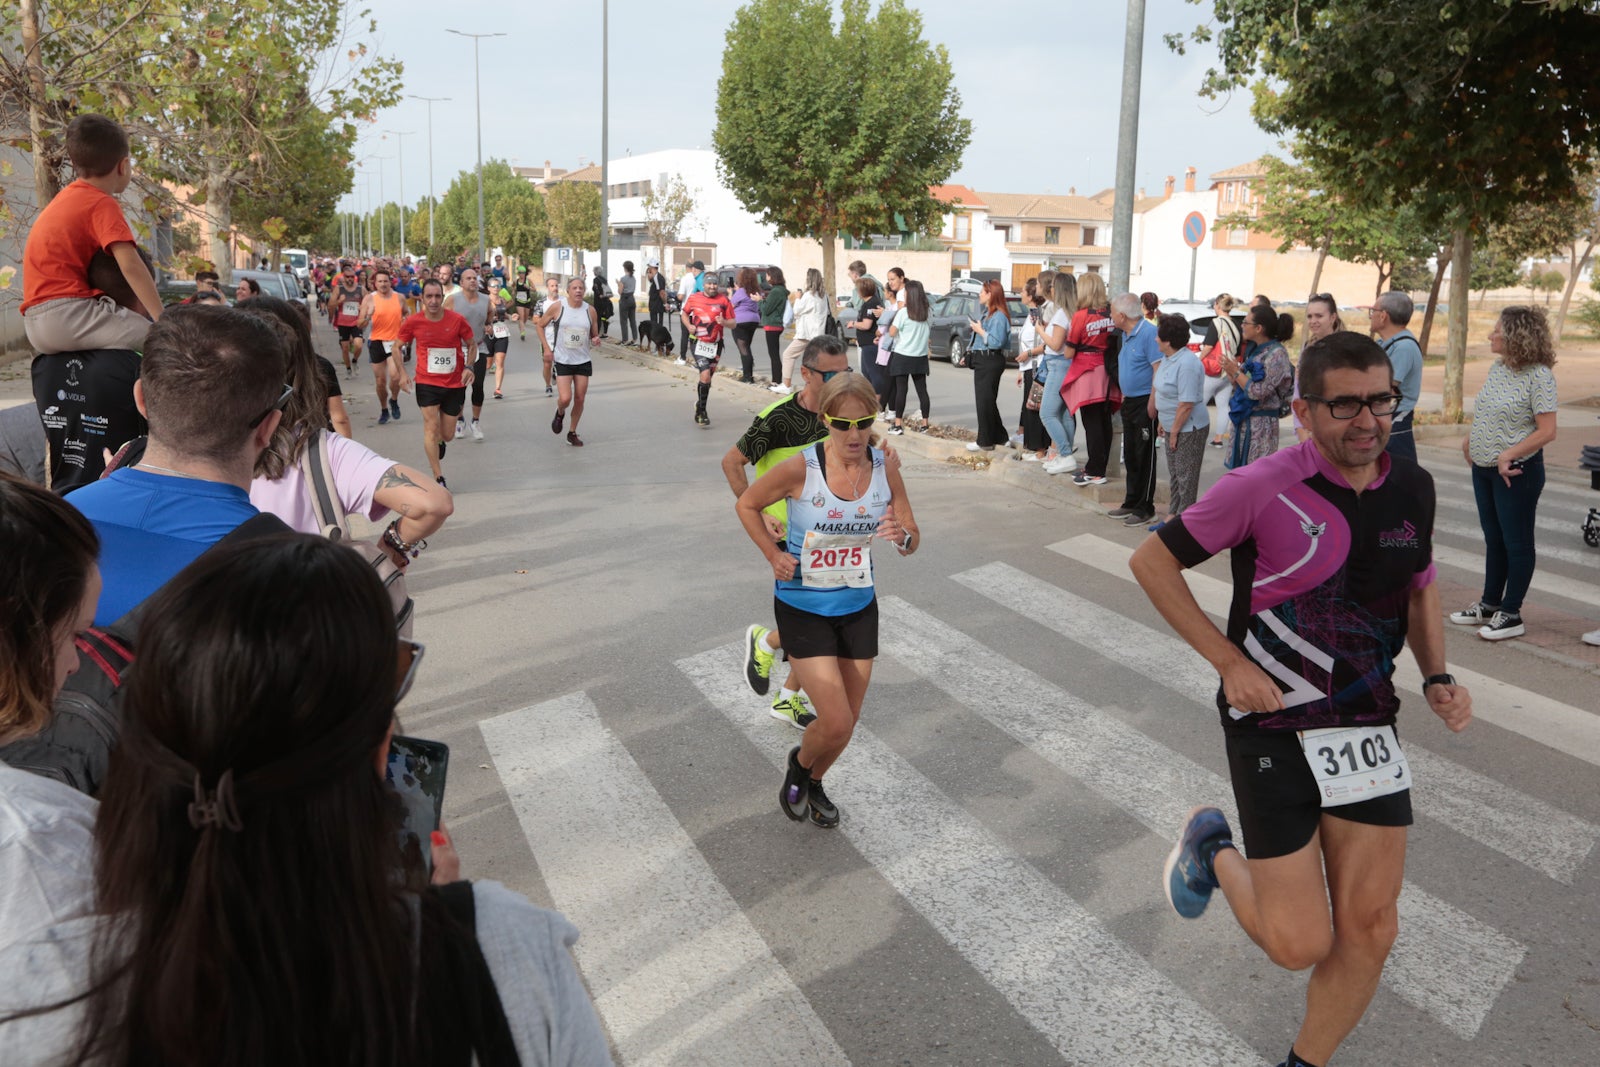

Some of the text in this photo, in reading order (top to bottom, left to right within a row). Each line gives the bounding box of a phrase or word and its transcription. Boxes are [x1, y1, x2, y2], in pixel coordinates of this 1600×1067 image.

[699, 344, 714, 354] 3015
[434, 356, 451, 365] 295
[814, 522, 880, 532] MARACENA
[810, 547, 862, 568] 2075
[1318, 733, 1391, 776] 3103
